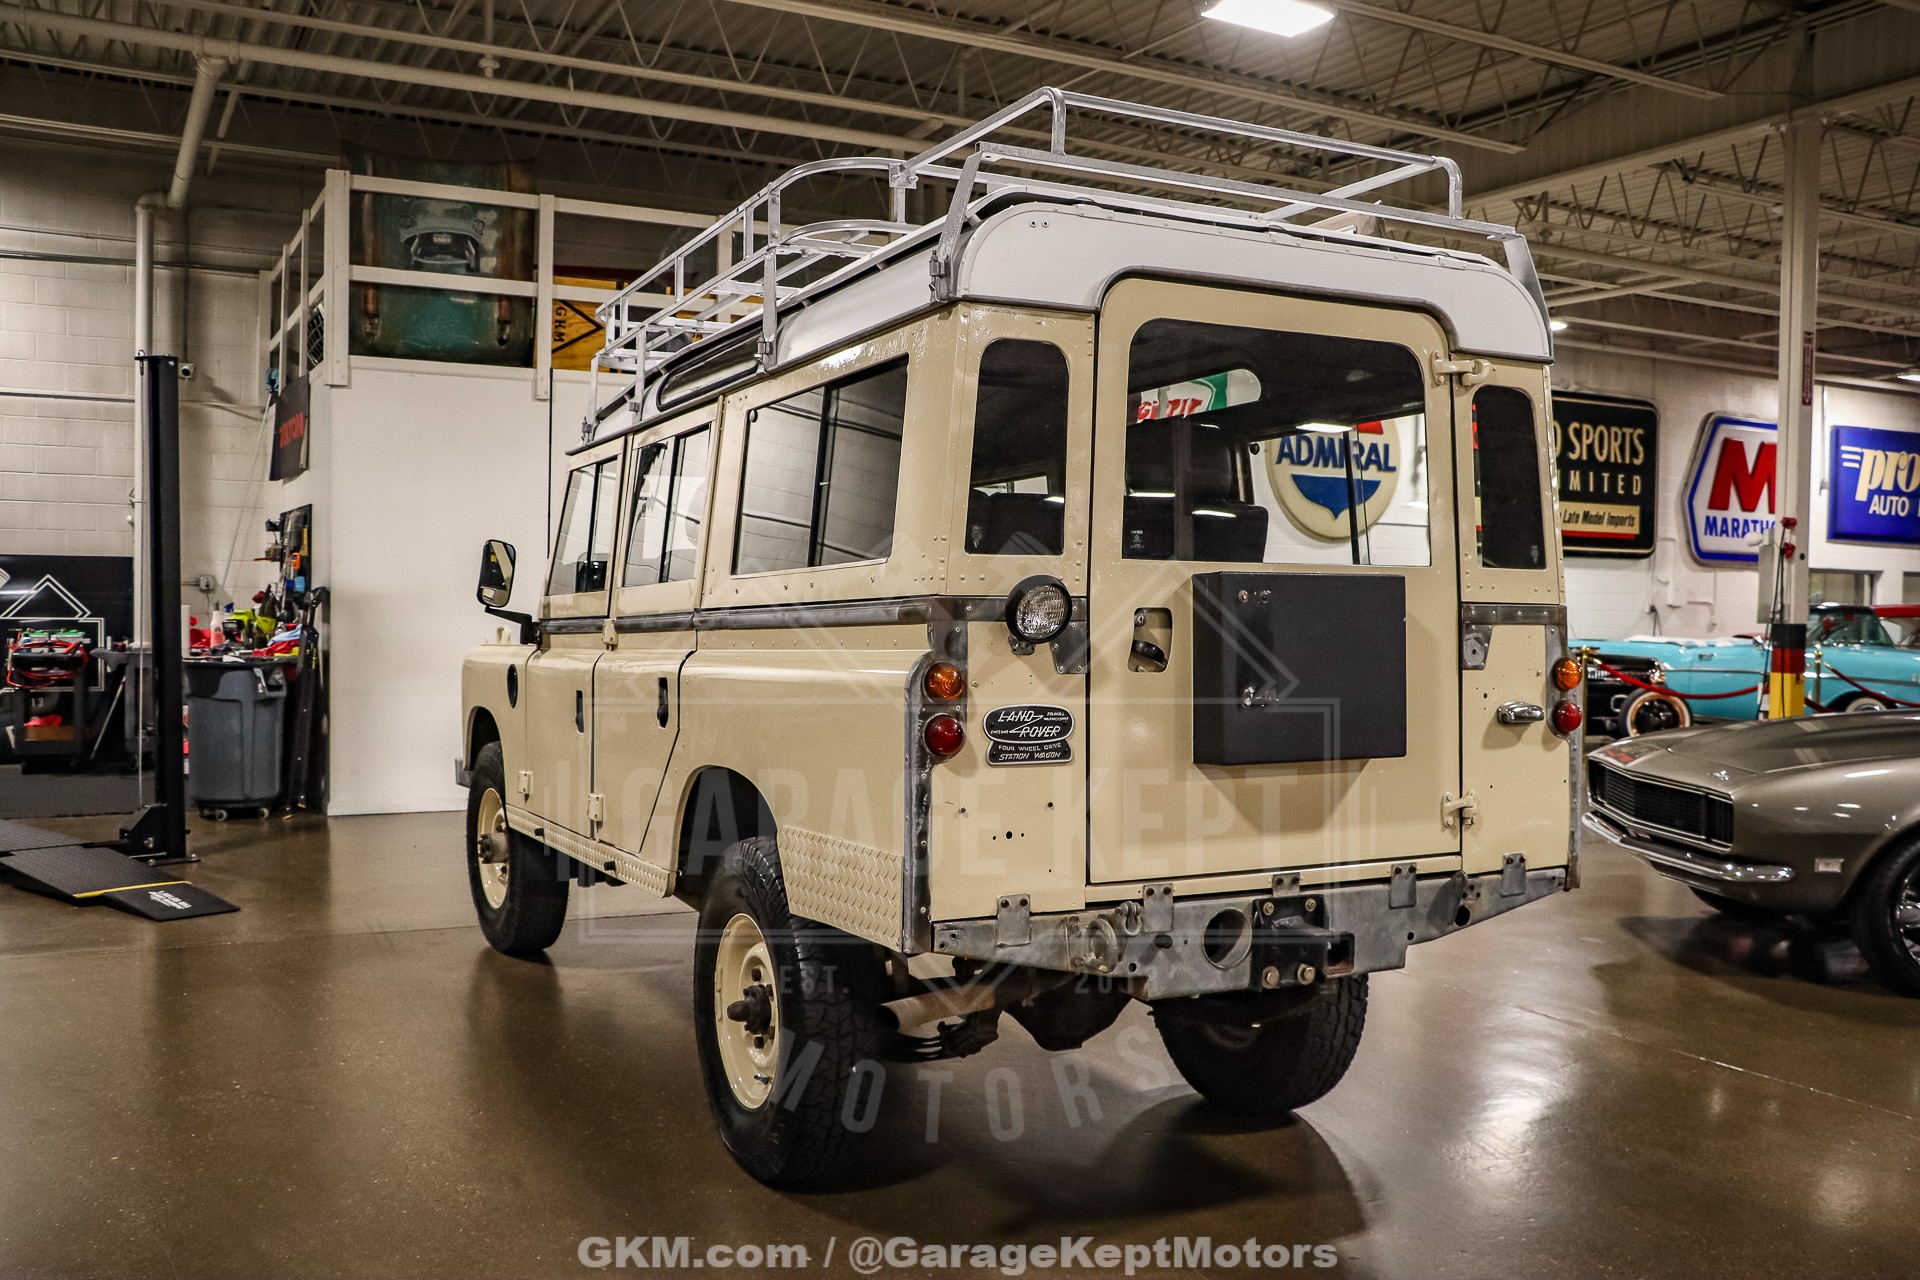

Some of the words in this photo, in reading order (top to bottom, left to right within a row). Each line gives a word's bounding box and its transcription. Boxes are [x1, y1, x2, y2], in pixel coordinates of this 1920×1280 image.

[554, 306, 566, 342] GKM
[1275, 433, 1397, 472] ADMIRAL
[1567, 421, 1645, 465] SPORTS
[1707, 437, 1778, 514] M
[1868, 494, 1910, 517] AUTO
[1562, 510, 1580, 524] Late
[1580, 510, 1606, 526] Model
[998, 711, 1035, 722] LAND
[1019, 726, 1061, 737] ROVER
[998, 752, 1030, 761] STATION
[1034, 751, 1061, 759] WAGON
